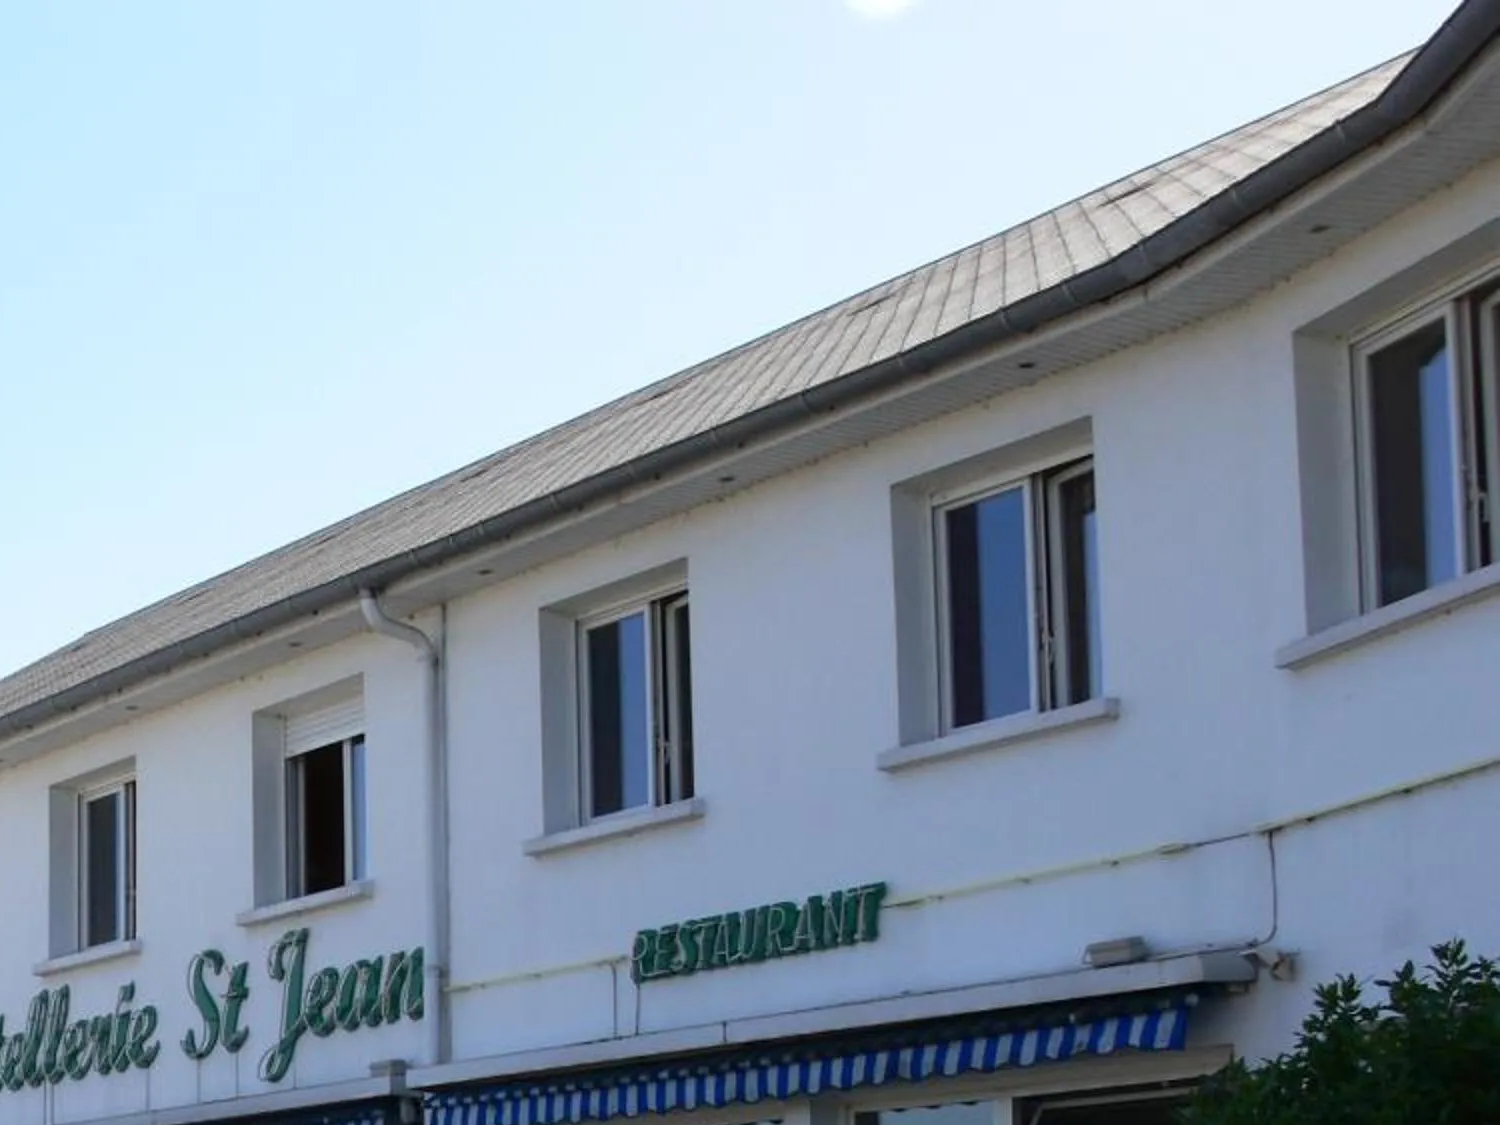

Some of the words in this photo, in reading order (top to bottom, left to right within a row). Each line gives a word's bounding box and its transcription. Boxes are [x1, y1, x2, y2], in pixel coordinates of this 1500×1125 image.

[631, 881, 887, 985] RESTAURANT
[180, 949, 250, 1060] St
[257, 927, 424, 1083] Jean
